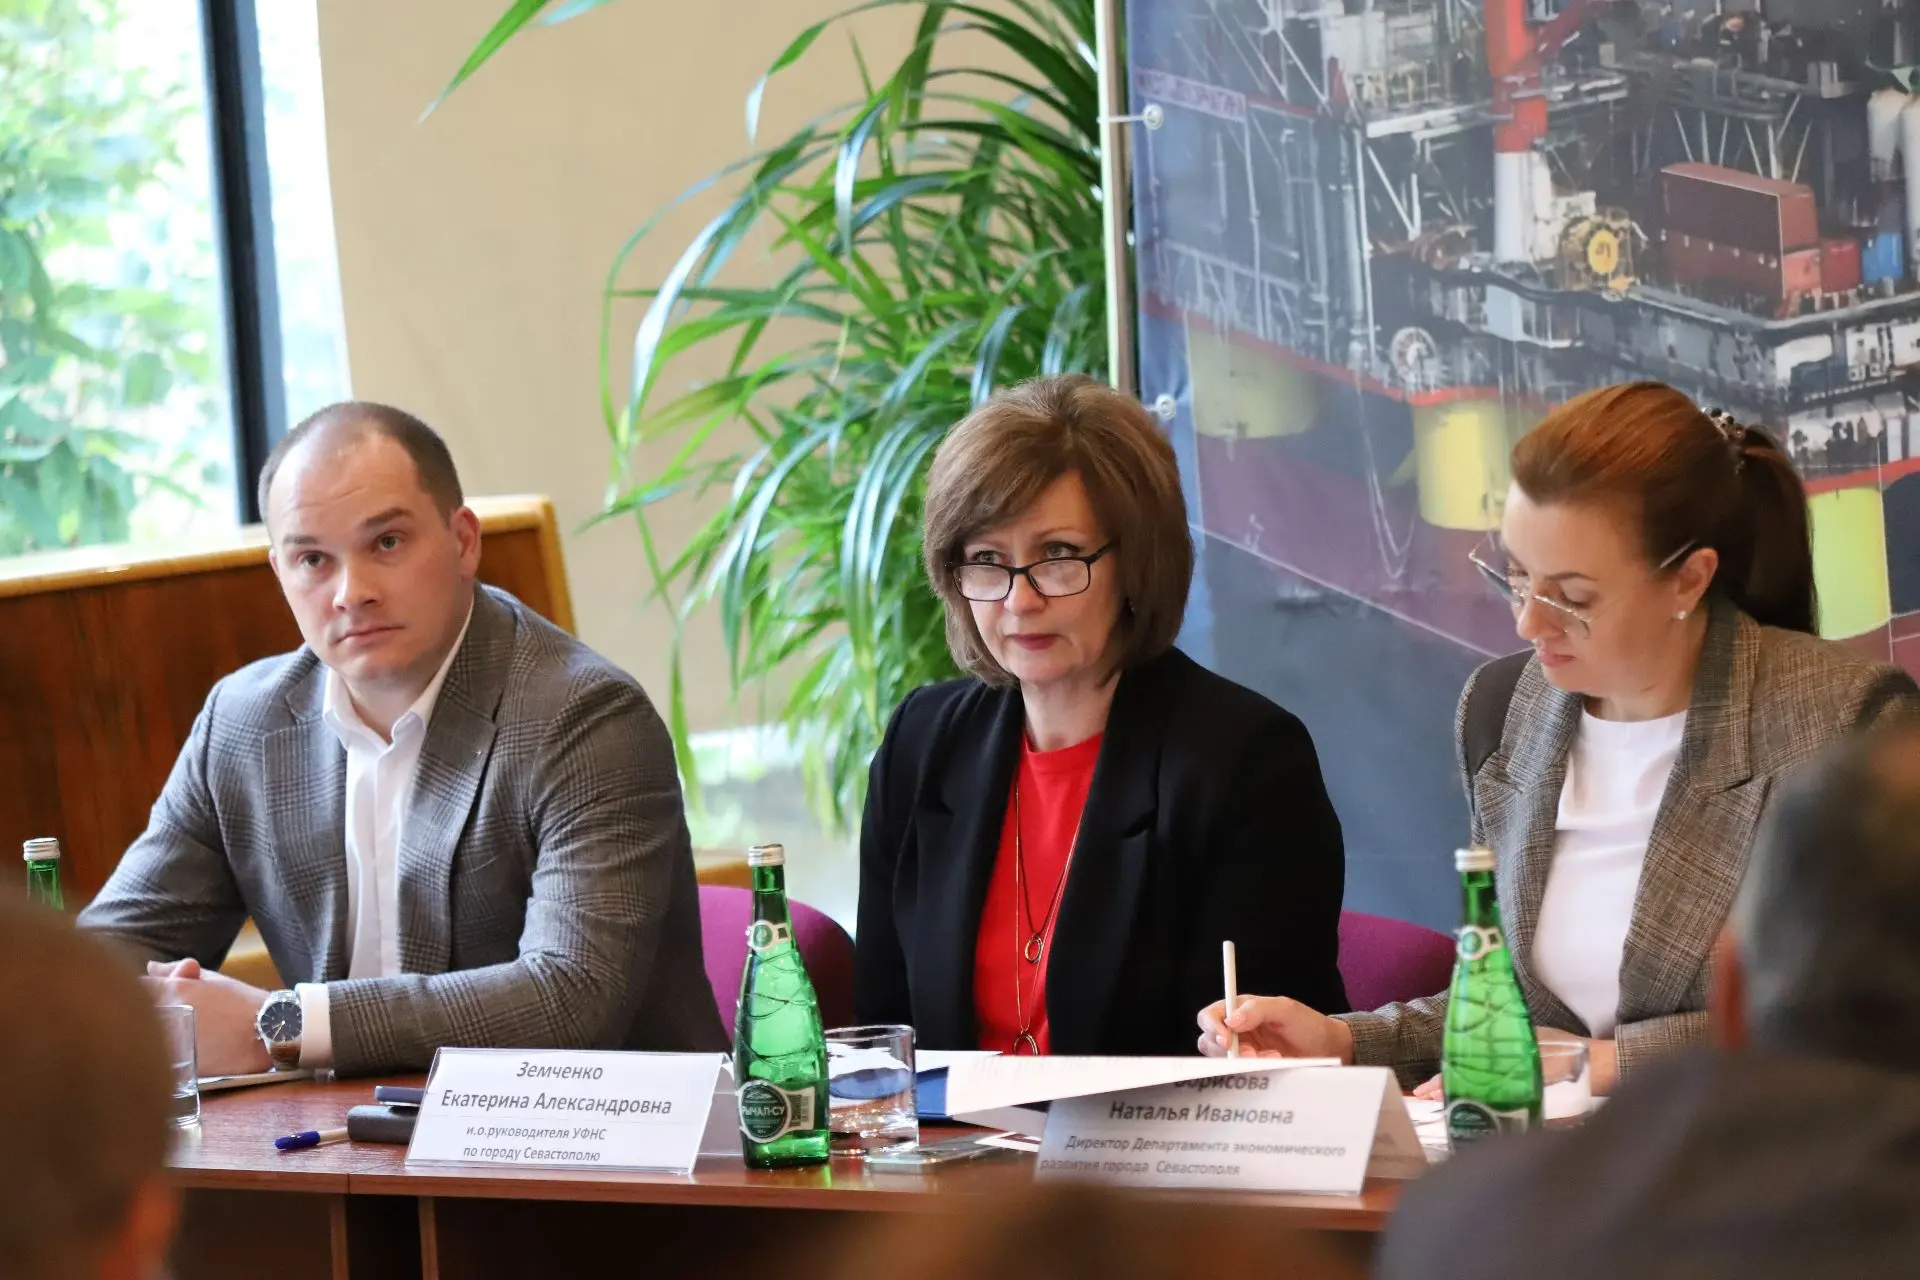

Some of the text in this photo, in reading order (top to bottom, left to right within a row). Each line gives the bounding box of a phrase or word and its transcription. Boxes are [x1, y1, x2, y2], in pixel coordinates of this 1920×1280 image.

[516, 1061, 603, 1080] Земченко
[441, 1089, 672, 1116] Екатерина Александровна
[1109, 1101, 1294, 1125] Наталья Ивановна
[466, 1126, 607, 1140] и.о.руководителя УФНС
[463, 1147, 601, 1161] по городу Севастополю
[1065, 1135, 1346, 1157] Директор Департамента экономического
[1040, 1158, 1240, 1176] развития города Севастополя
